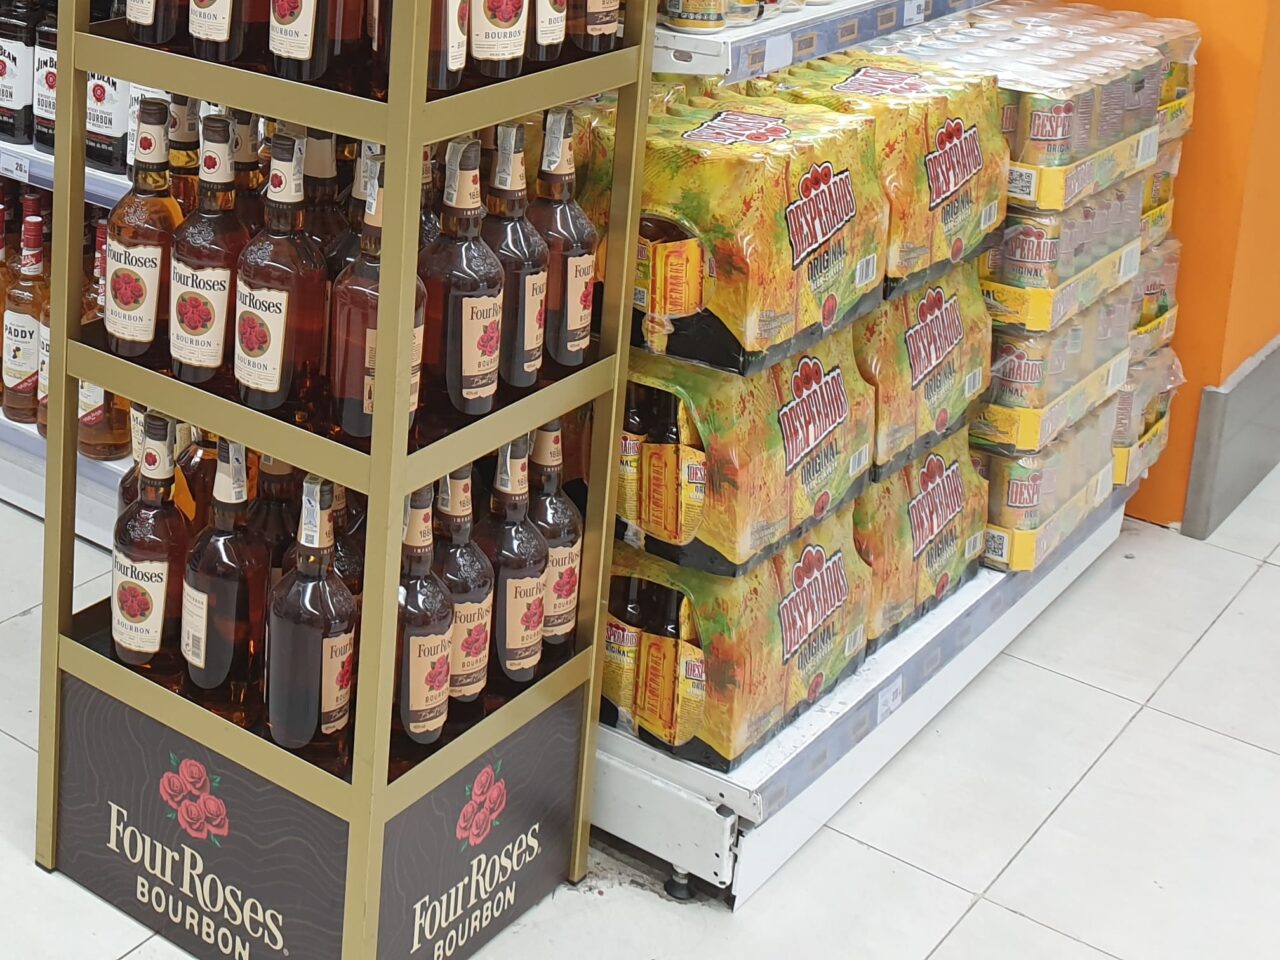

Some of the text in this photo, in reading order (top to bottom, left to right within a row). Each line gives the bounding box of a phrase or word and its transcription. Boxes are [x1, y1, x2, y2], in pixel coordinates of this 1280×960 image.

[926, 128, 983, 202] DESPERADOS
[787, 172, 856, 261] DESPERADOS
[5, 324, 35, 340] PADDY
[906, 298, 964, 383] DESPERADOS
[780, 371, 848, 470] DESPERADOS
[909, 467, 964, 554] DESPERADOS
[780, 555, 848, 658] DESPERADOS
[136, 875, 250, 960] BOURBON
[433, 881, 516, 960] BOURBON
